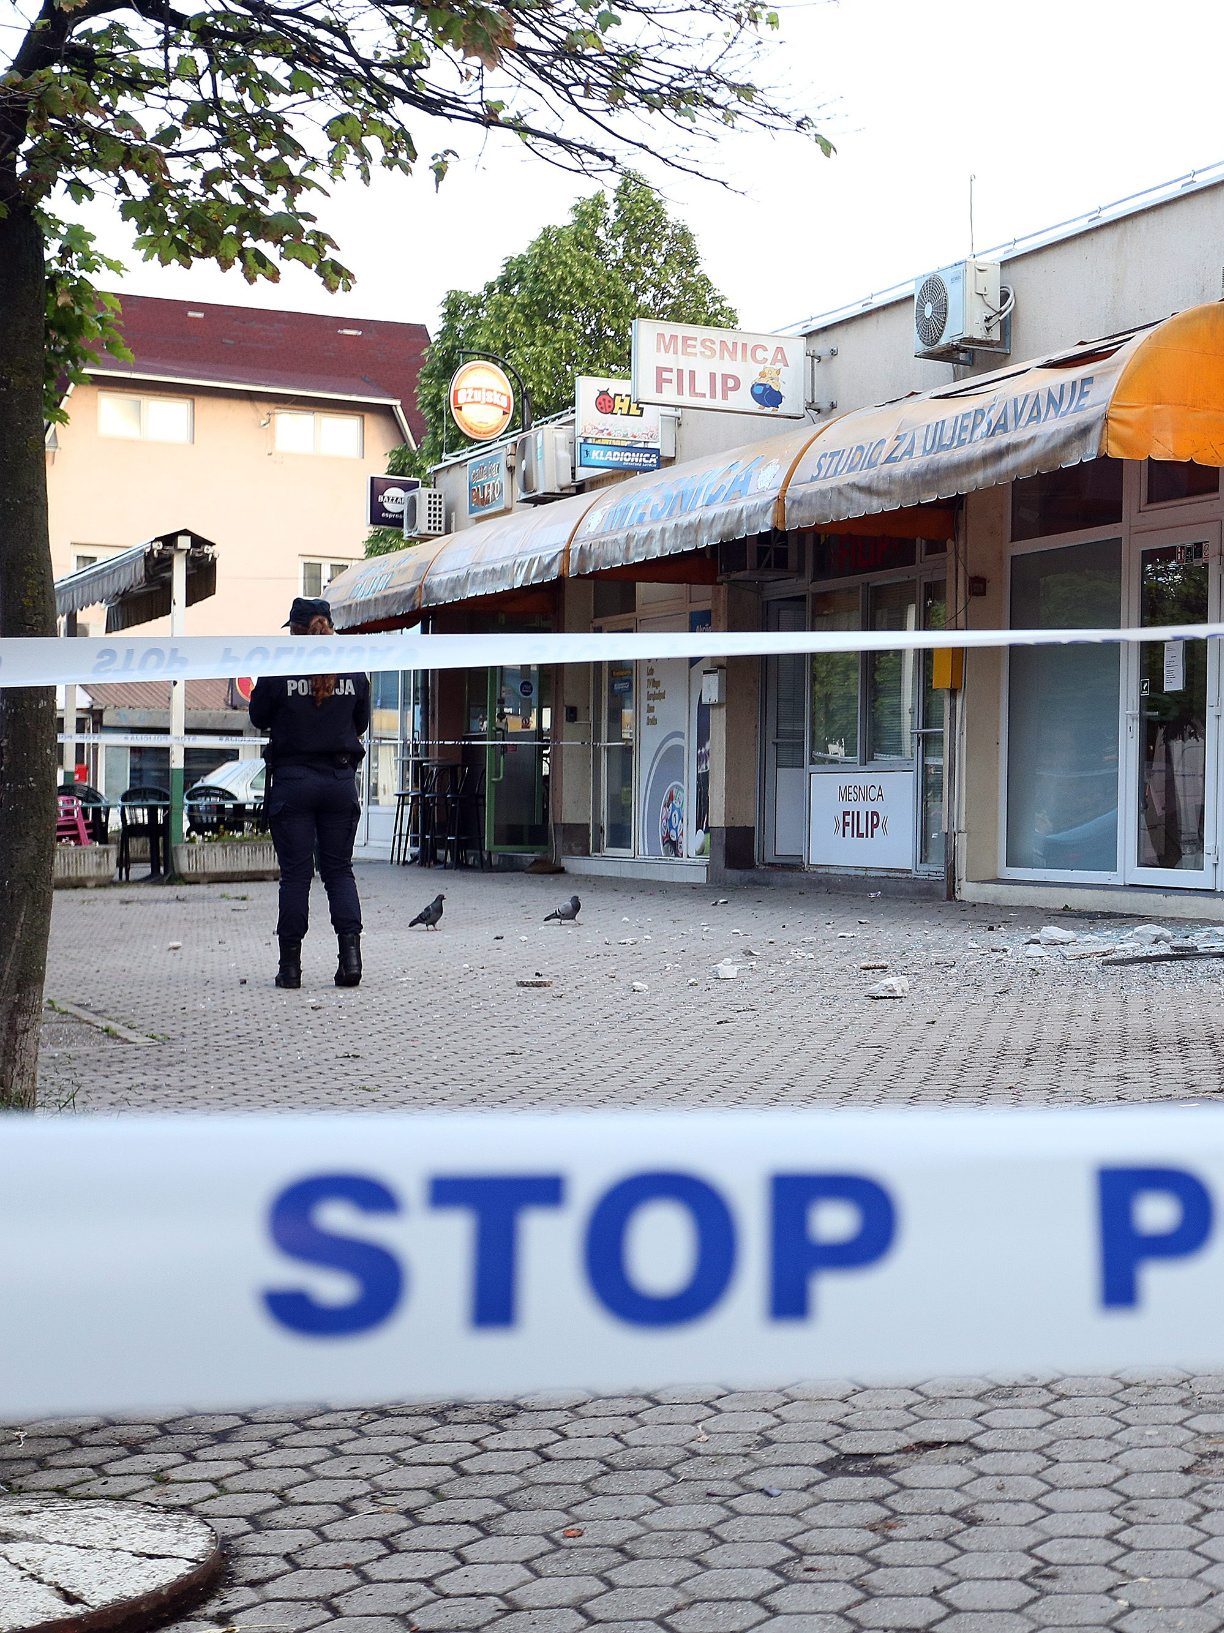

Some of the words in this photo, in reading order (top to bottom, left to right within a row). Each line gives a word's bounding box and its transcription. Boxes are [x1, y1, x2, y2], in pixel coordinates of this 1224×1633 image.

[656, 332, 790, 368] MESNICA
[655, 366, 741, 401] FILIP
[591, 449, 658, 464] KLADIONICA
[810, 438, 887, 482] STUDIO
[881, 431, 916, 465] ZA
[838, 785, 884, 802] MESNICA
[258, 1168, 900, 1340] STOP
